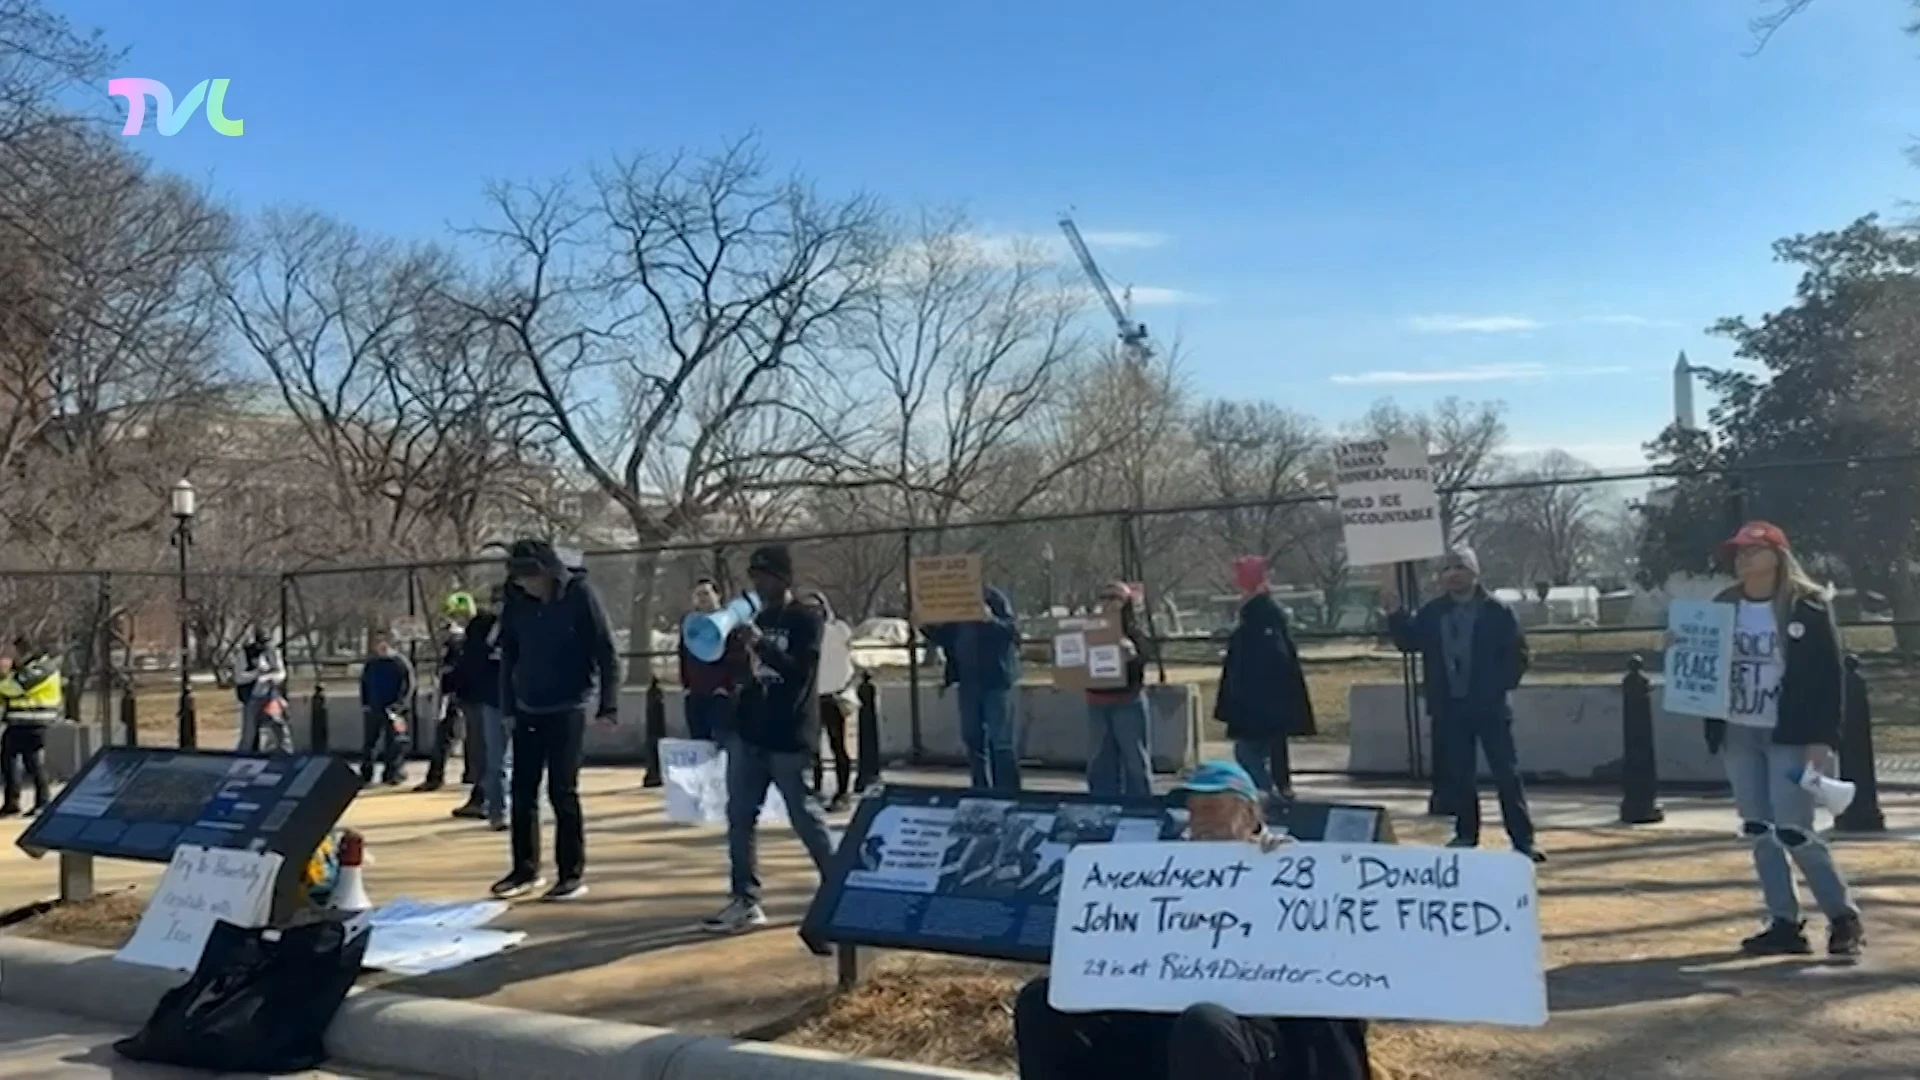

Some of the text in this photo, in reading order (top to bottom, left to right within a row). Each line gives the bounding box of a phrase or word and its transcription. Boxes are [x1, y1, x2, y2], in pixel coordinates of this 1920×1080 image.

[1341, 493, 1402, 509] HOLD ICE
[1344, 507, 1433, 525] ACCOUNTABLE
[1674, 650, 1720, 682] PEACE
[1271, 856, 1317, 890] 28
[1072, 902, 1139, 934] John
[1150, 897, 1253, 950] Trump,
[1277, 893, 1380, 935] YOU'RE
[1395, 894, 1529, 936] FIRED."
[1083, 959, 1107, 977] 29
[1110, 960, 1125, 977] is
[1128, 958, 1149, 977] at
